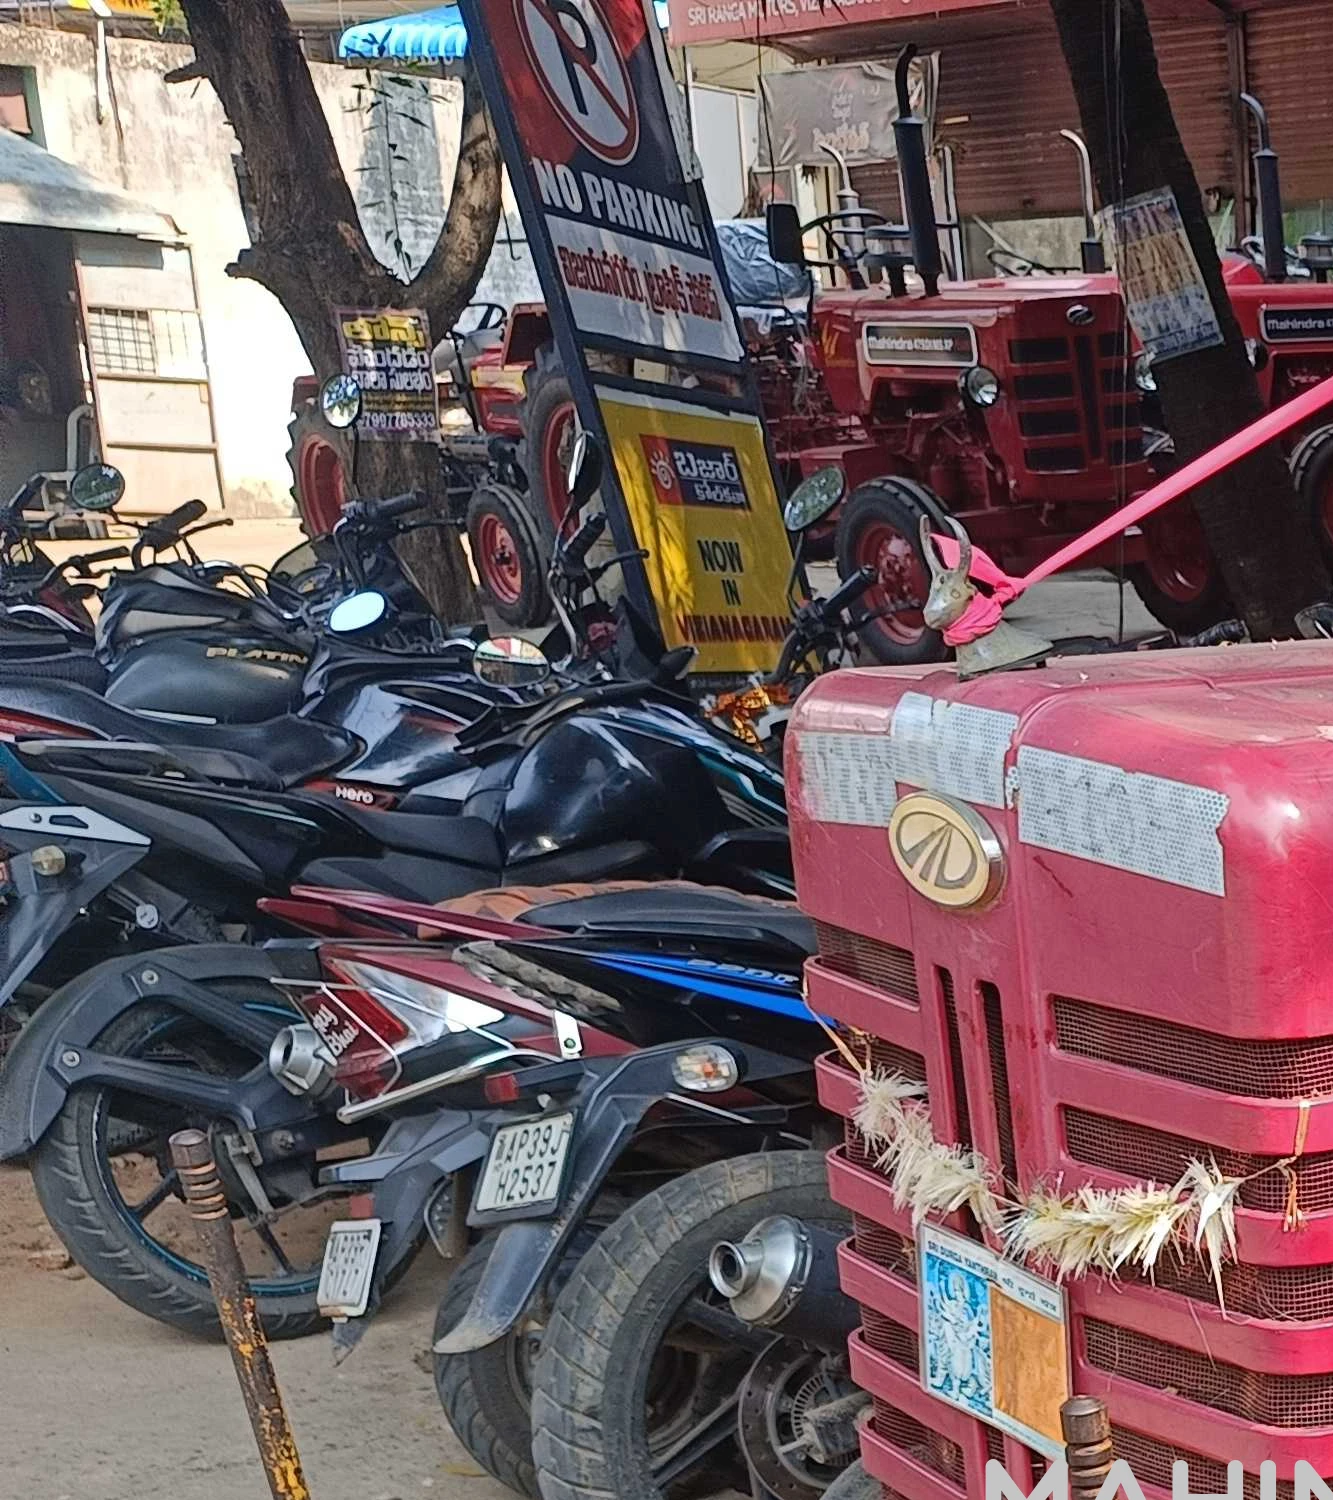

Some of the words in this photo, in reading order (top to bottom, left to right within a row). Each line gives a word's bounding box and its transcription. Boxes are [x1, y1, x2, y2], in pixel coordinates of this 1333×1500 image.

[531, 155, 584, 214] NO
[581, 171, 704, 250] PARKING
[1266, 318, 1325, 331] Mahindra
[697, 539, 744, 573] NOW
[721, 579, 742, 606] IN
[335, 785, 374, 804] Hero
[495, 1160, 557, 1204] H2537
